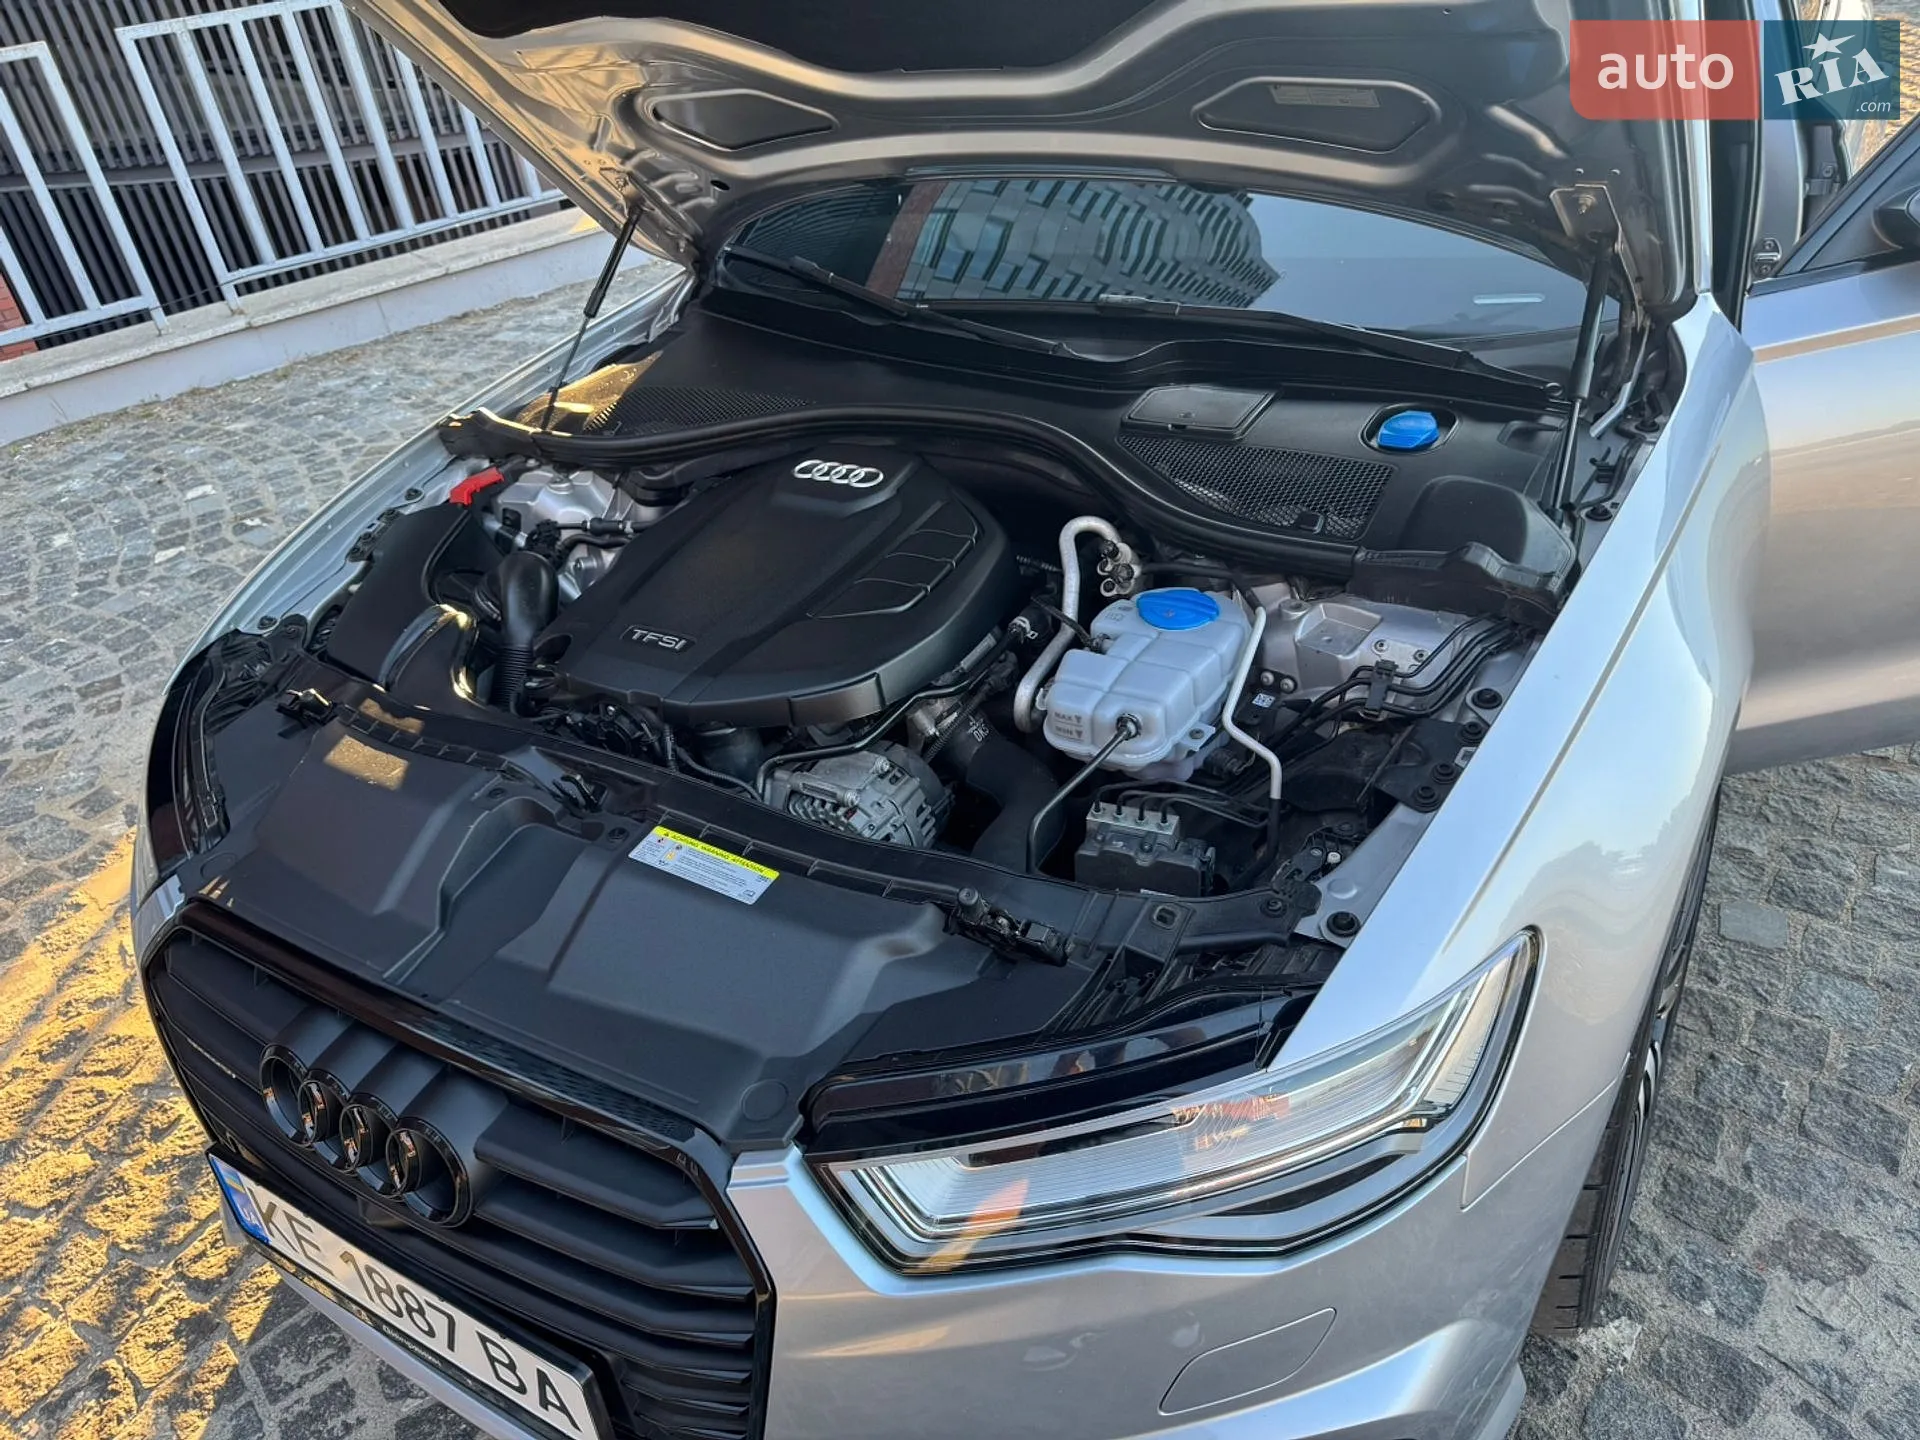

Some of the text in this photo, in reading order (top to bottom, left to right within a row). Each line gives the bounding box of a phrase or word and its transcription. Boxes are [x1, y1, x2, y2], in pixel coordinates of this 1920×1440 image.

[632, 629, 687, 650] TFSI
[247, 1187, 335, 1278] KE
[340, 1251, 456, 1352] 1887
[475, 1330, 582, 1432] BA
